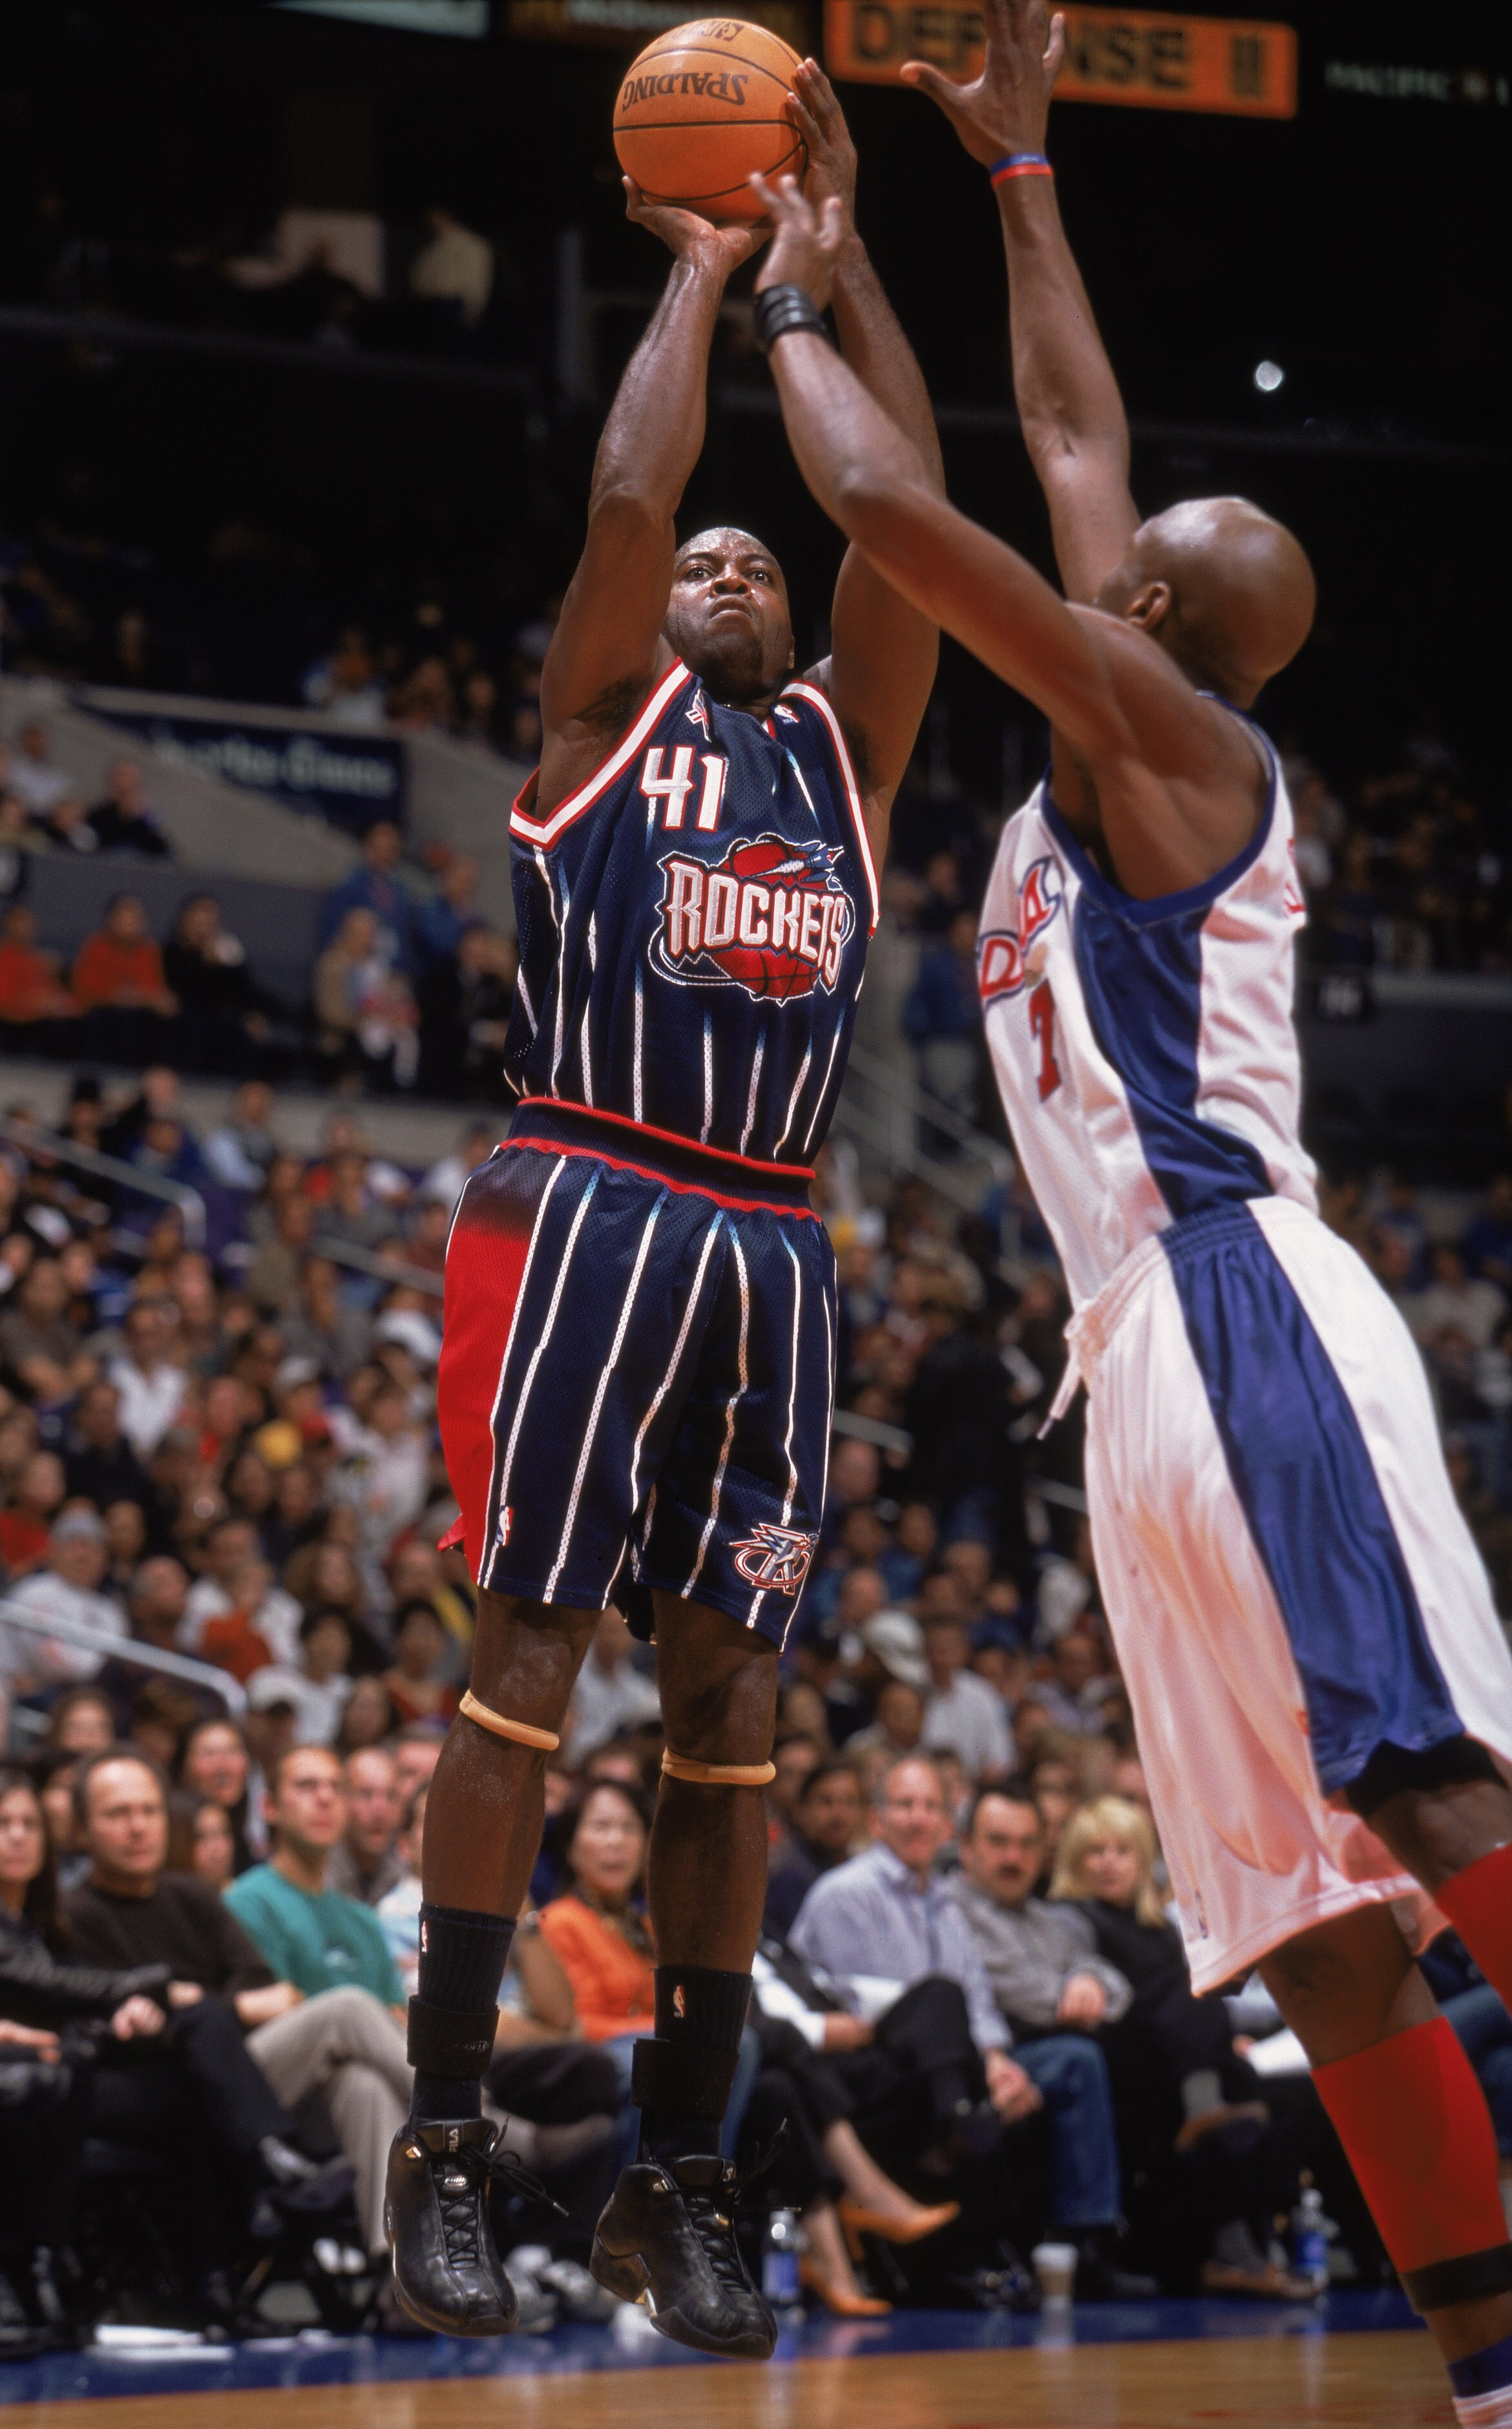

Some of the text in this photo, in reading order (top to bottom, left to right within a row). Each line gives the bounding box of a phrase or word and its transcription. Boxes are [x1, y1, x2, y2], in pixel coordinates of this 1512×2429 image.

[851, 3, 1190, 92] DEFNSE
[622, 72, 750, 112] SPALDING
[641, 745, 726, 832] 41
[666, 859, 846, 987] ROCKETS
